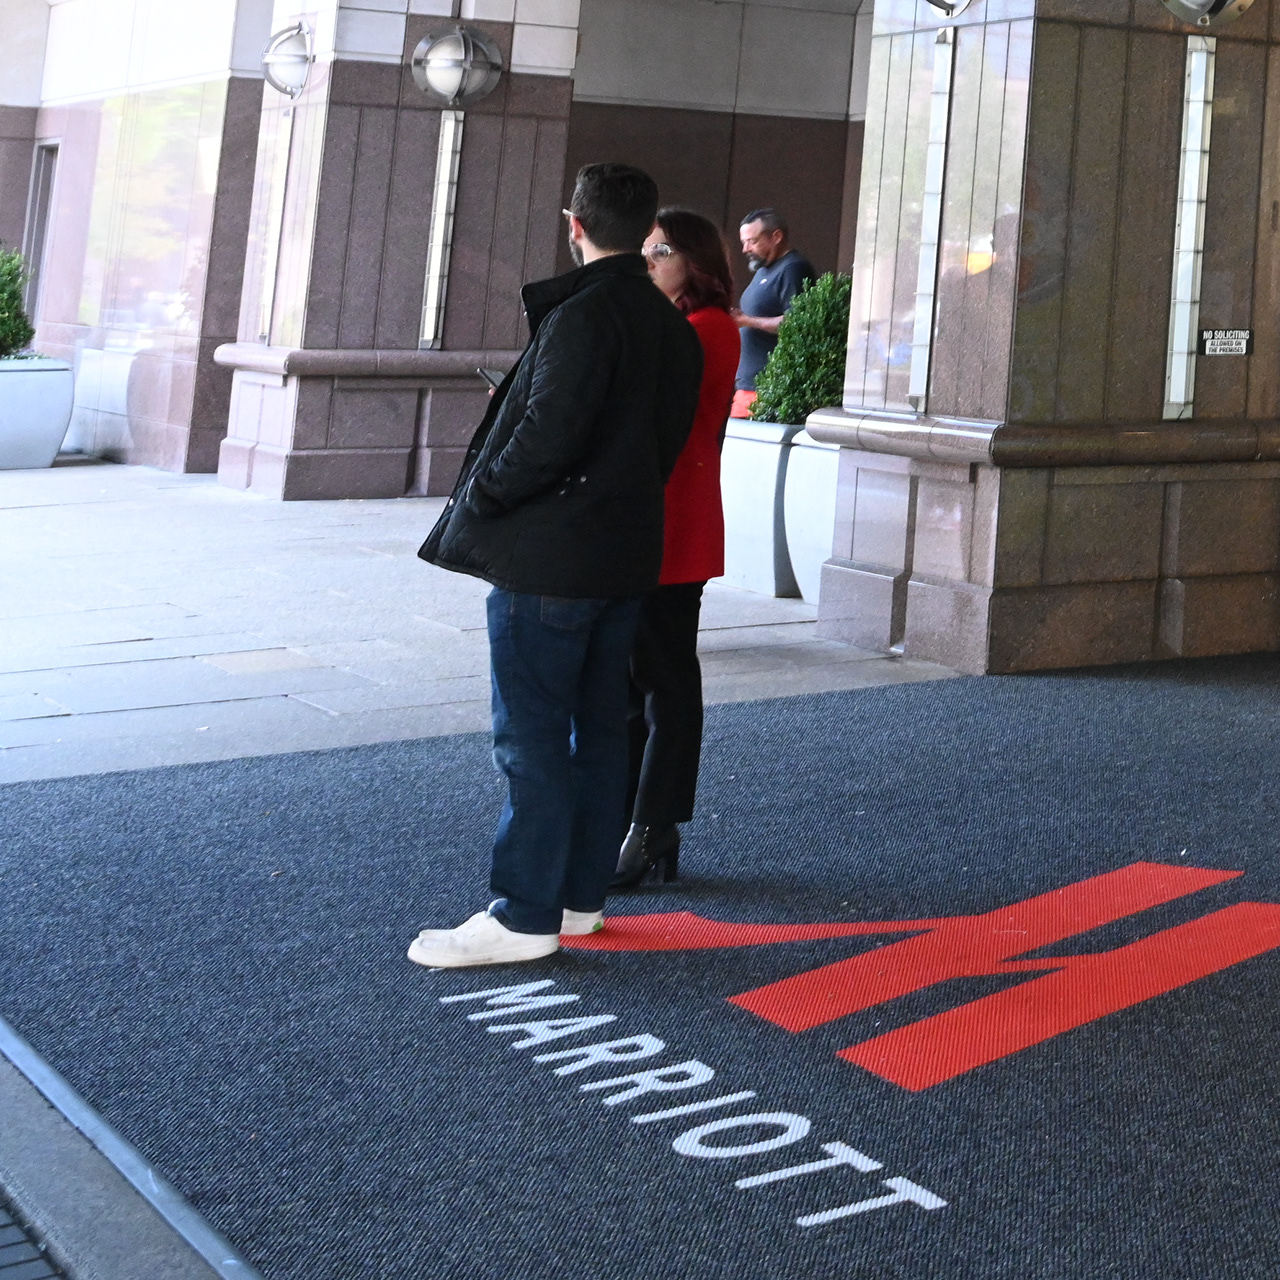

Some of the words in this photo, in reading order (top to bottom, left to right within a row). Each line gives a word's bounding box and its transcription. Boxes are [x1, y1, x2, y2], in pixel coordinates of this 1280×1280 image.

[1203, 330, 1213, 340] NO
[1214, 330, 1249, 340] SOLICITING
[438, 979, 948, 1227] MARRIOTT
